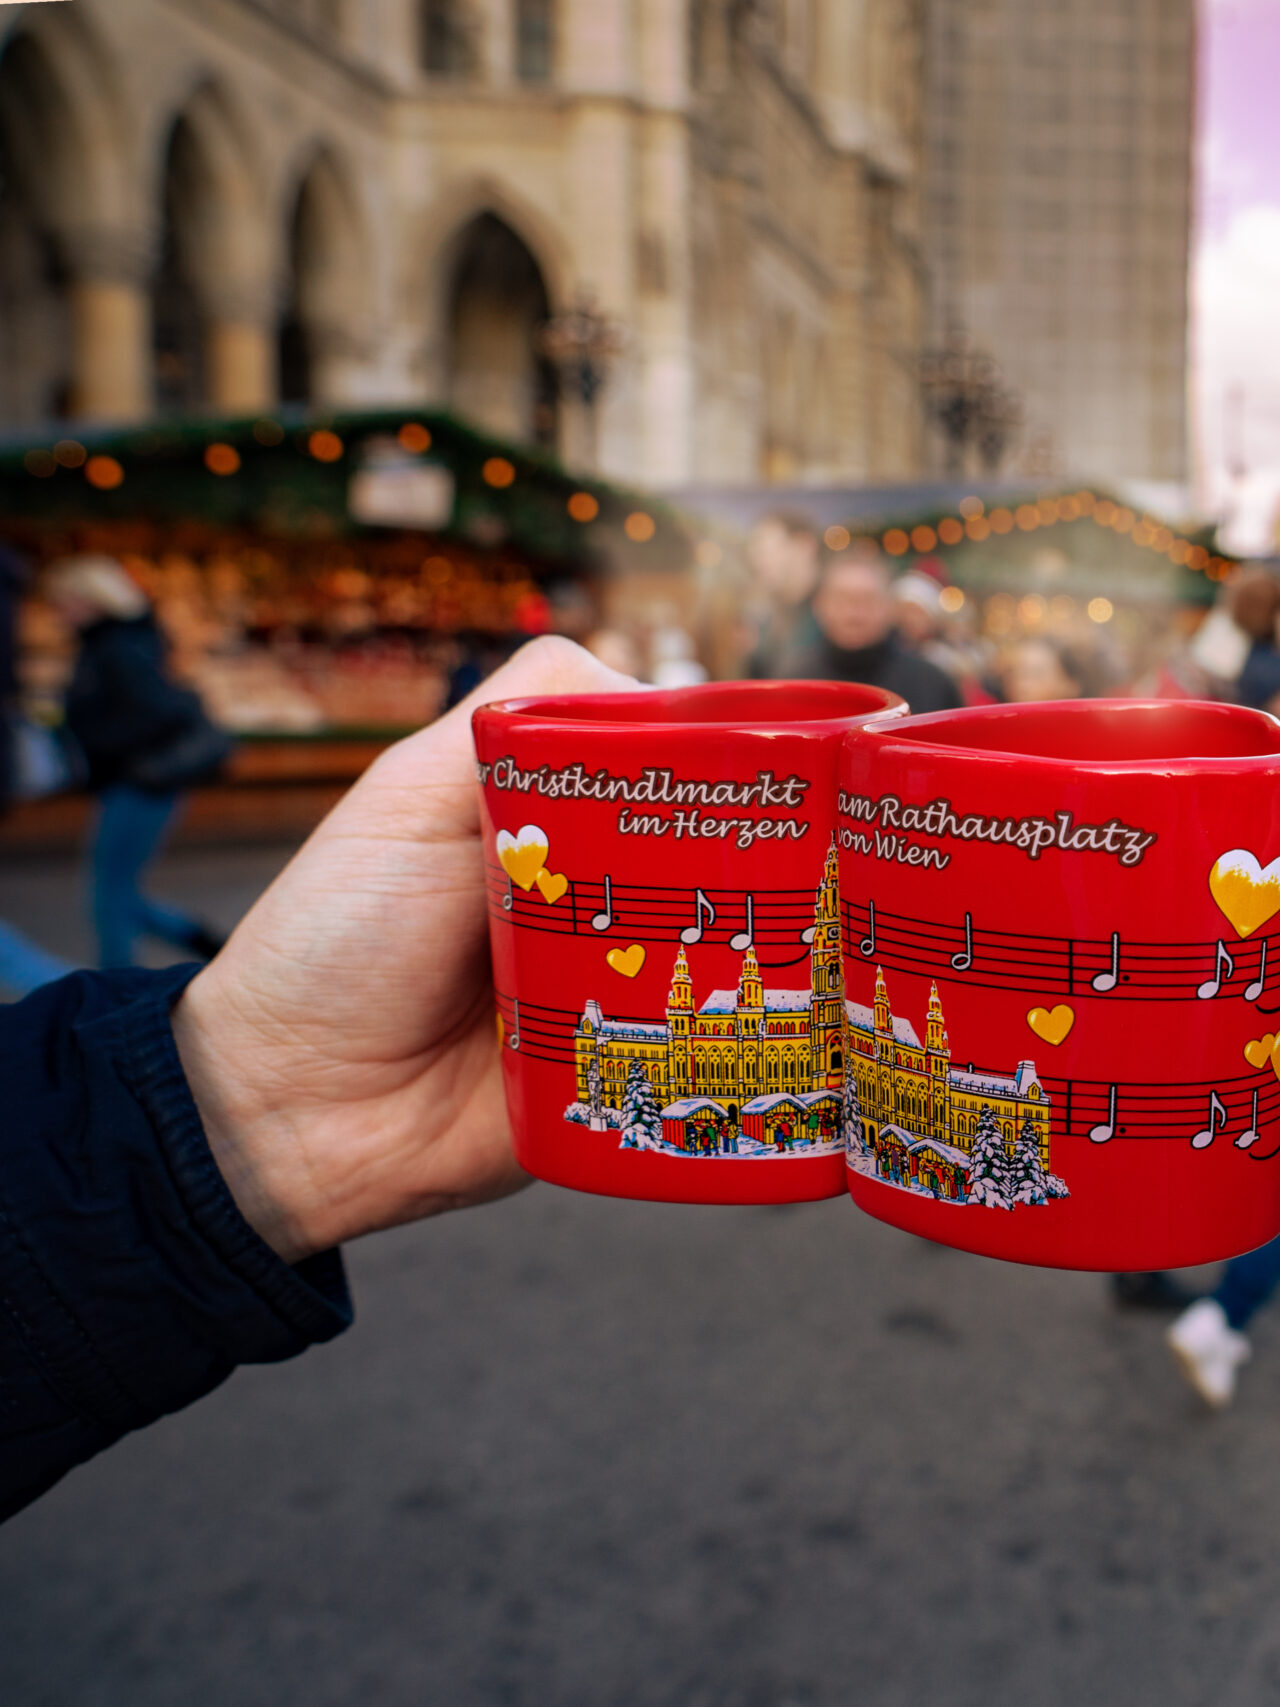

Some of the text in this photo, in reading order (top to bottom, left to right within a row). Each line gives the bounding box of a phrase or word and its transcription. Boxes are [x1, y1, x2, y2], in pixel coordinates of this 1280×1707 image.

[492, 757, 808, 807] Christkindlmarkt
[618, 808, 808, 849] im Herzen
[838, 791, 1154, 865] am Rathausplatz
[838, 826, 950, 870] von Wien
